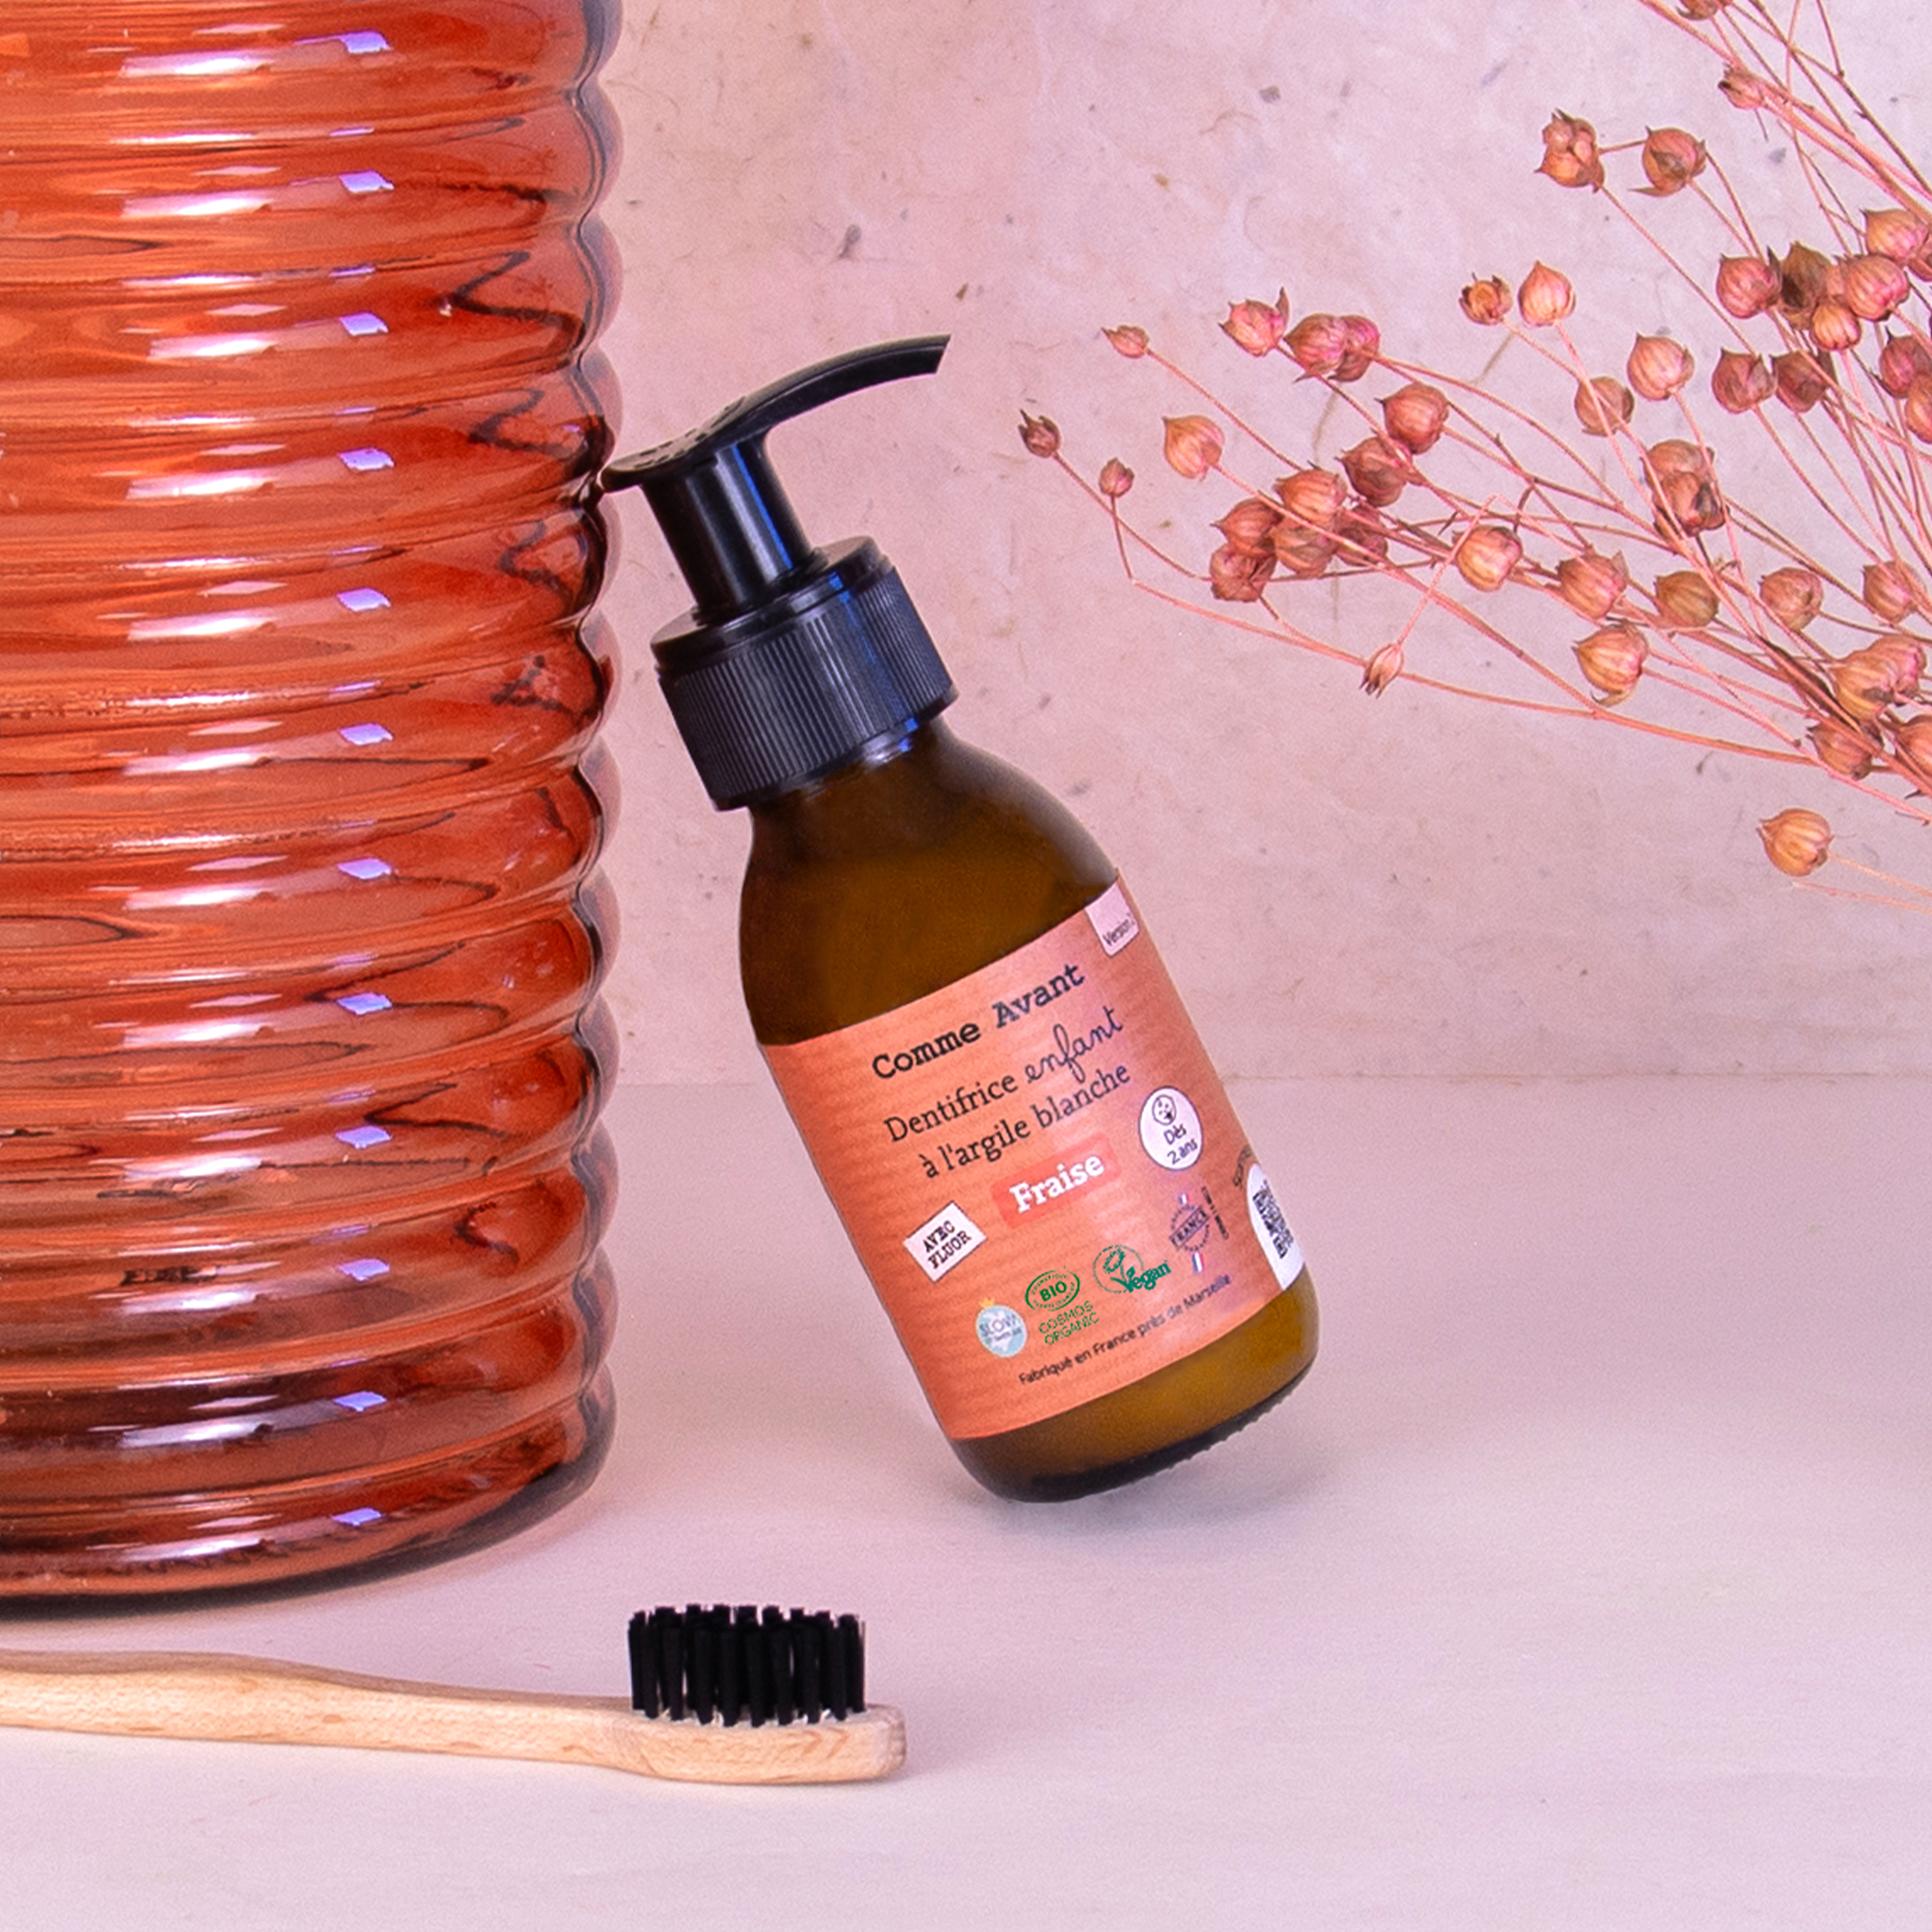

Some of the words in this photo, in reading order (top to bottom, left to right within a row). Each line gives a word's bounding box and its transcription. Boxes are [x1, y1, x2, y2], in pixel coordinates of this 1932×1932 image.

[873, 1023, 981, 1078] Comme
[991, 963, 1085, 1028] Avant
[883, 1074, 1018, 1142] Dentifrice
[1024, 1005, 1124, 1084] enfant
[919, 1154, 940, 1178] à
[938, 1119, 1031, 1172] l'argile
[1030, 1064, 1130, 1128] blanche
[1163, 1123, 1188, 1145] Dès
[1167, 1149, 1178, 1165] 2
[1178, 1138, 1198, 1158] ans
[1009, 1156, 1105, 1213] Fraise
[923, 1220, 956, 1254] AVEC
[928, 1230, 972, 1269] FLUOR
[1040, 1281, 1067, 1302] BIO
[1110, 1260, 1172, 1292] Vegan
[1019, 1356, 1074, 1385] Fabriqué
[1074, 1349, 1091, 1364] en
[1091, 1329, 1136, 1356] France
[1137, 1312, 1166, 1338] près
[1166, 1302, 1184, 1319] de
[1182, 1274, 1230, 1307] Marseille
[1039, 1300, 1093, 1334] COSMOS
[1044, 1312, 1100, 1346] ORGANIC
